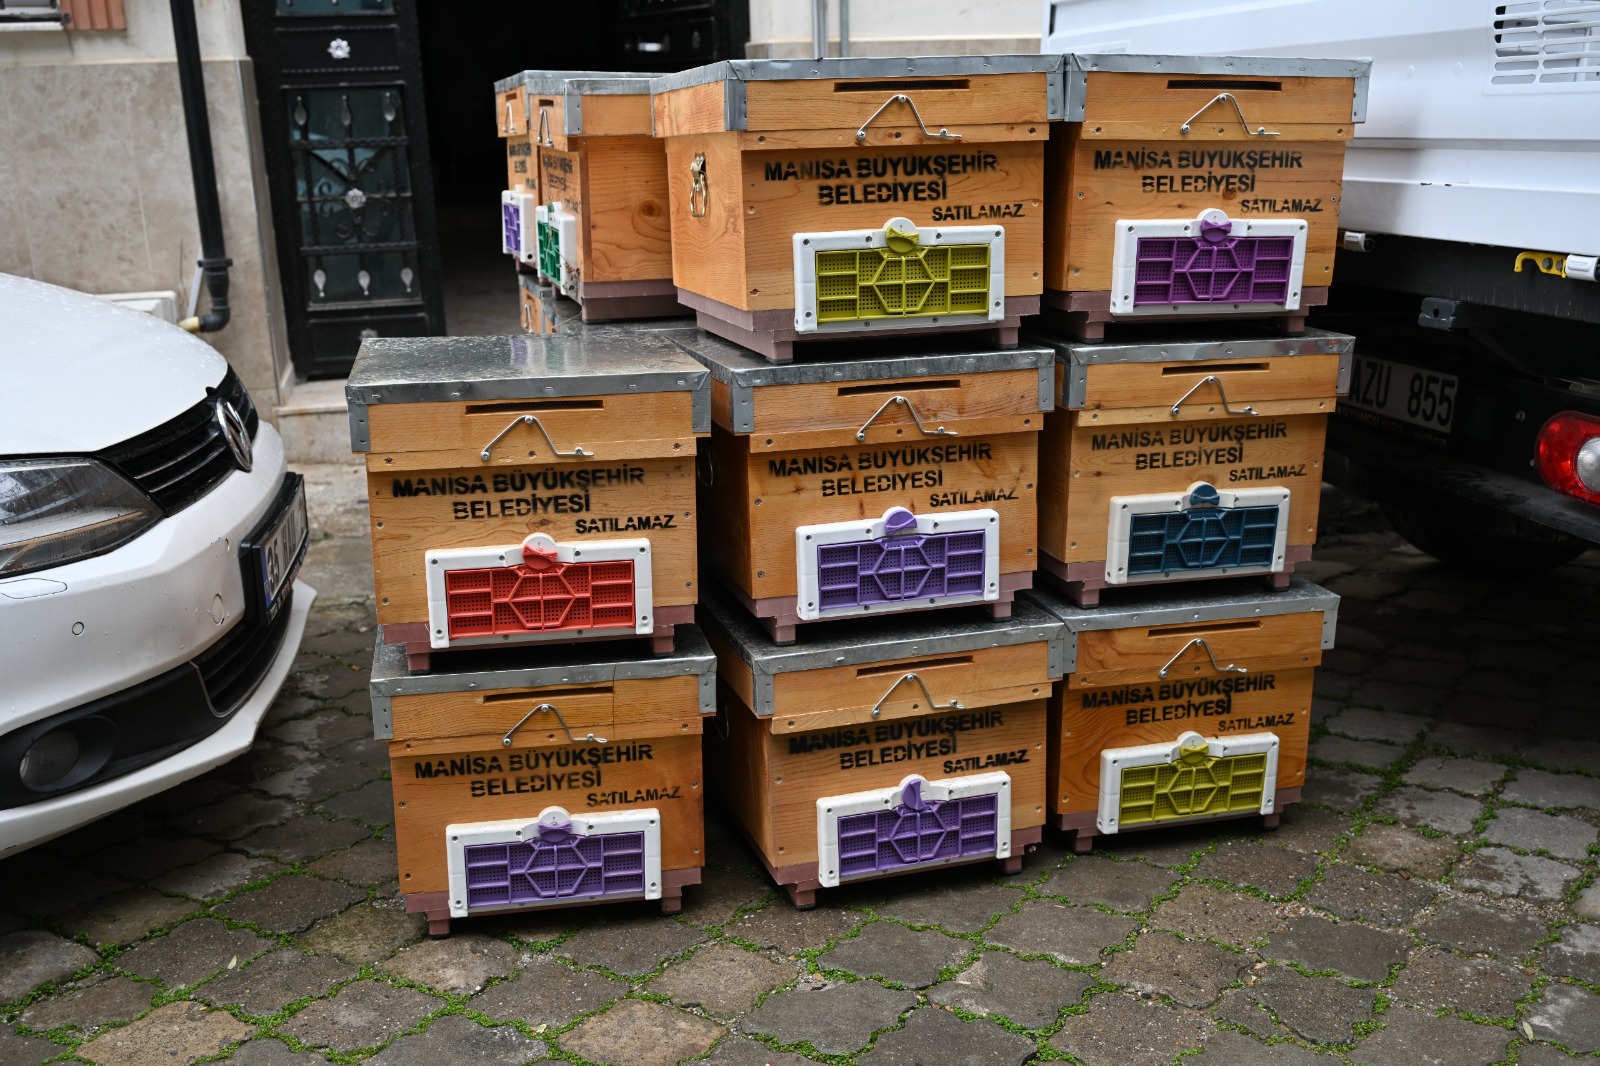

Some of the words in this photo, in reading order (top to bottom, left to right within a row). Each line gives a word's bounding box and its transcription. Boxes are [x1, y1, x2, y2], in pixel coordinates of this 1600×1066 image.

[1094, 147, 1172, 170] MANİSA
[818, 180, 947, 205] BELEDİYESİ
[1142, 172, 1256, 193] BELEDİYESİ
[1350, 358, 1391, 409] AZU
[1407, 373, 1455, 426] 855
[1092, 428, 1164, 450] MANİSA
[1170, 419, 1287, 445] BÜYÜKŞEHİR
[770, 452, 852, 477] MANİSA
[1136, 443, 1242, 470] BELEDİYESİ
[393, 474, 487, 497] MANİSA
[493, 464, 644, 492] BÜYÜKŞEHİR
[454, 490, 590, 519] BELEDİYESİ
[266, 538, 280, 592] 35
[1082, 686, 1155, 708] MANİSA
[1159, 674, 1276, 701] BÜYÜKŞEHİR
[1127, 695, 1231, 725] BELEDİYESİ
[415, 754, 502, 778] MANİSA
[510, 741, 653, 772] BÜYÜKŞEHİR
[840, 734, 956, 769] BELEDİYESİ
[472, 770, 601, 797] BELEDİYESİ
